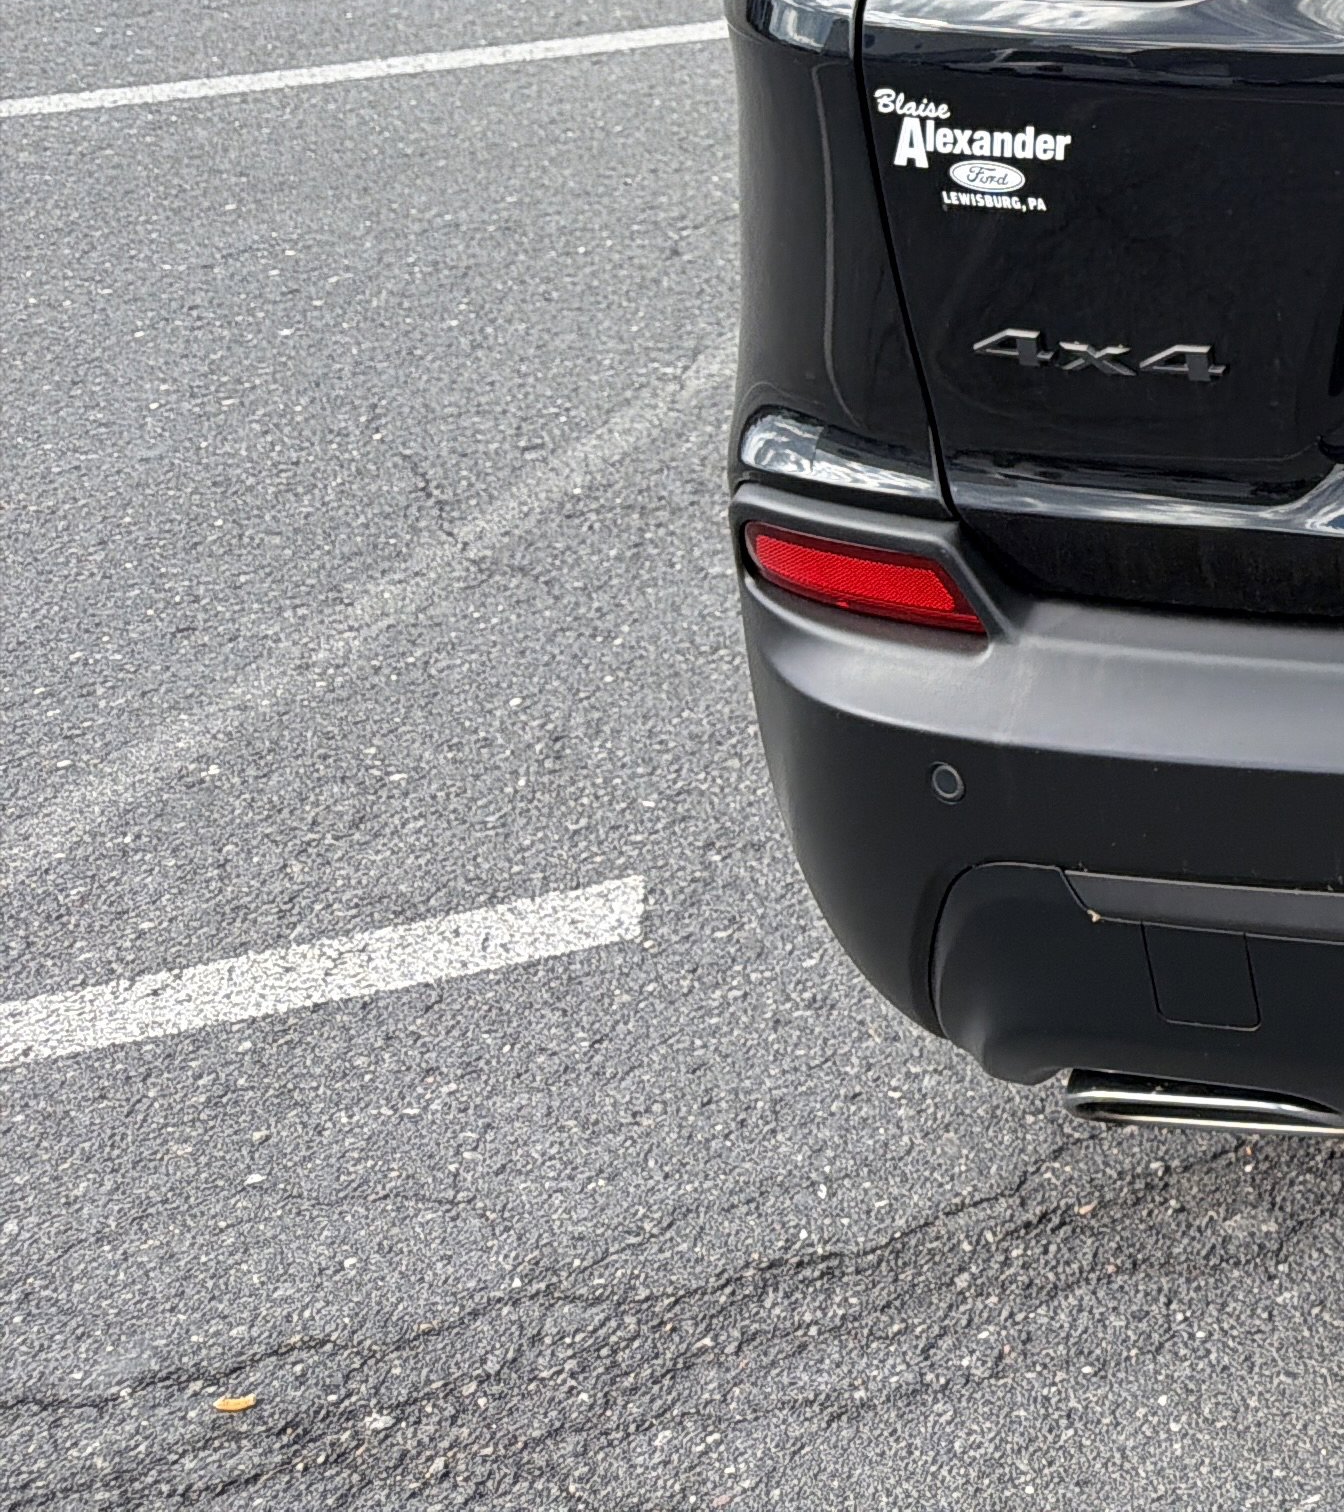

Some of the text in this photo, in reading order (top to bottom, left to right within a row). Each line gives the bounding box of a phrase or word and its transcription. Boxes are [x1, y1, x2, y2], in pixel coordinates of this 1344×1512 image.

[874, 88, 951, 119] Blaise
[894, 117, 1072, 169] Alexander
[965, 164, 1010, 187] Ford
[942, 191, 1048, 213] LEWISBURG, PA
